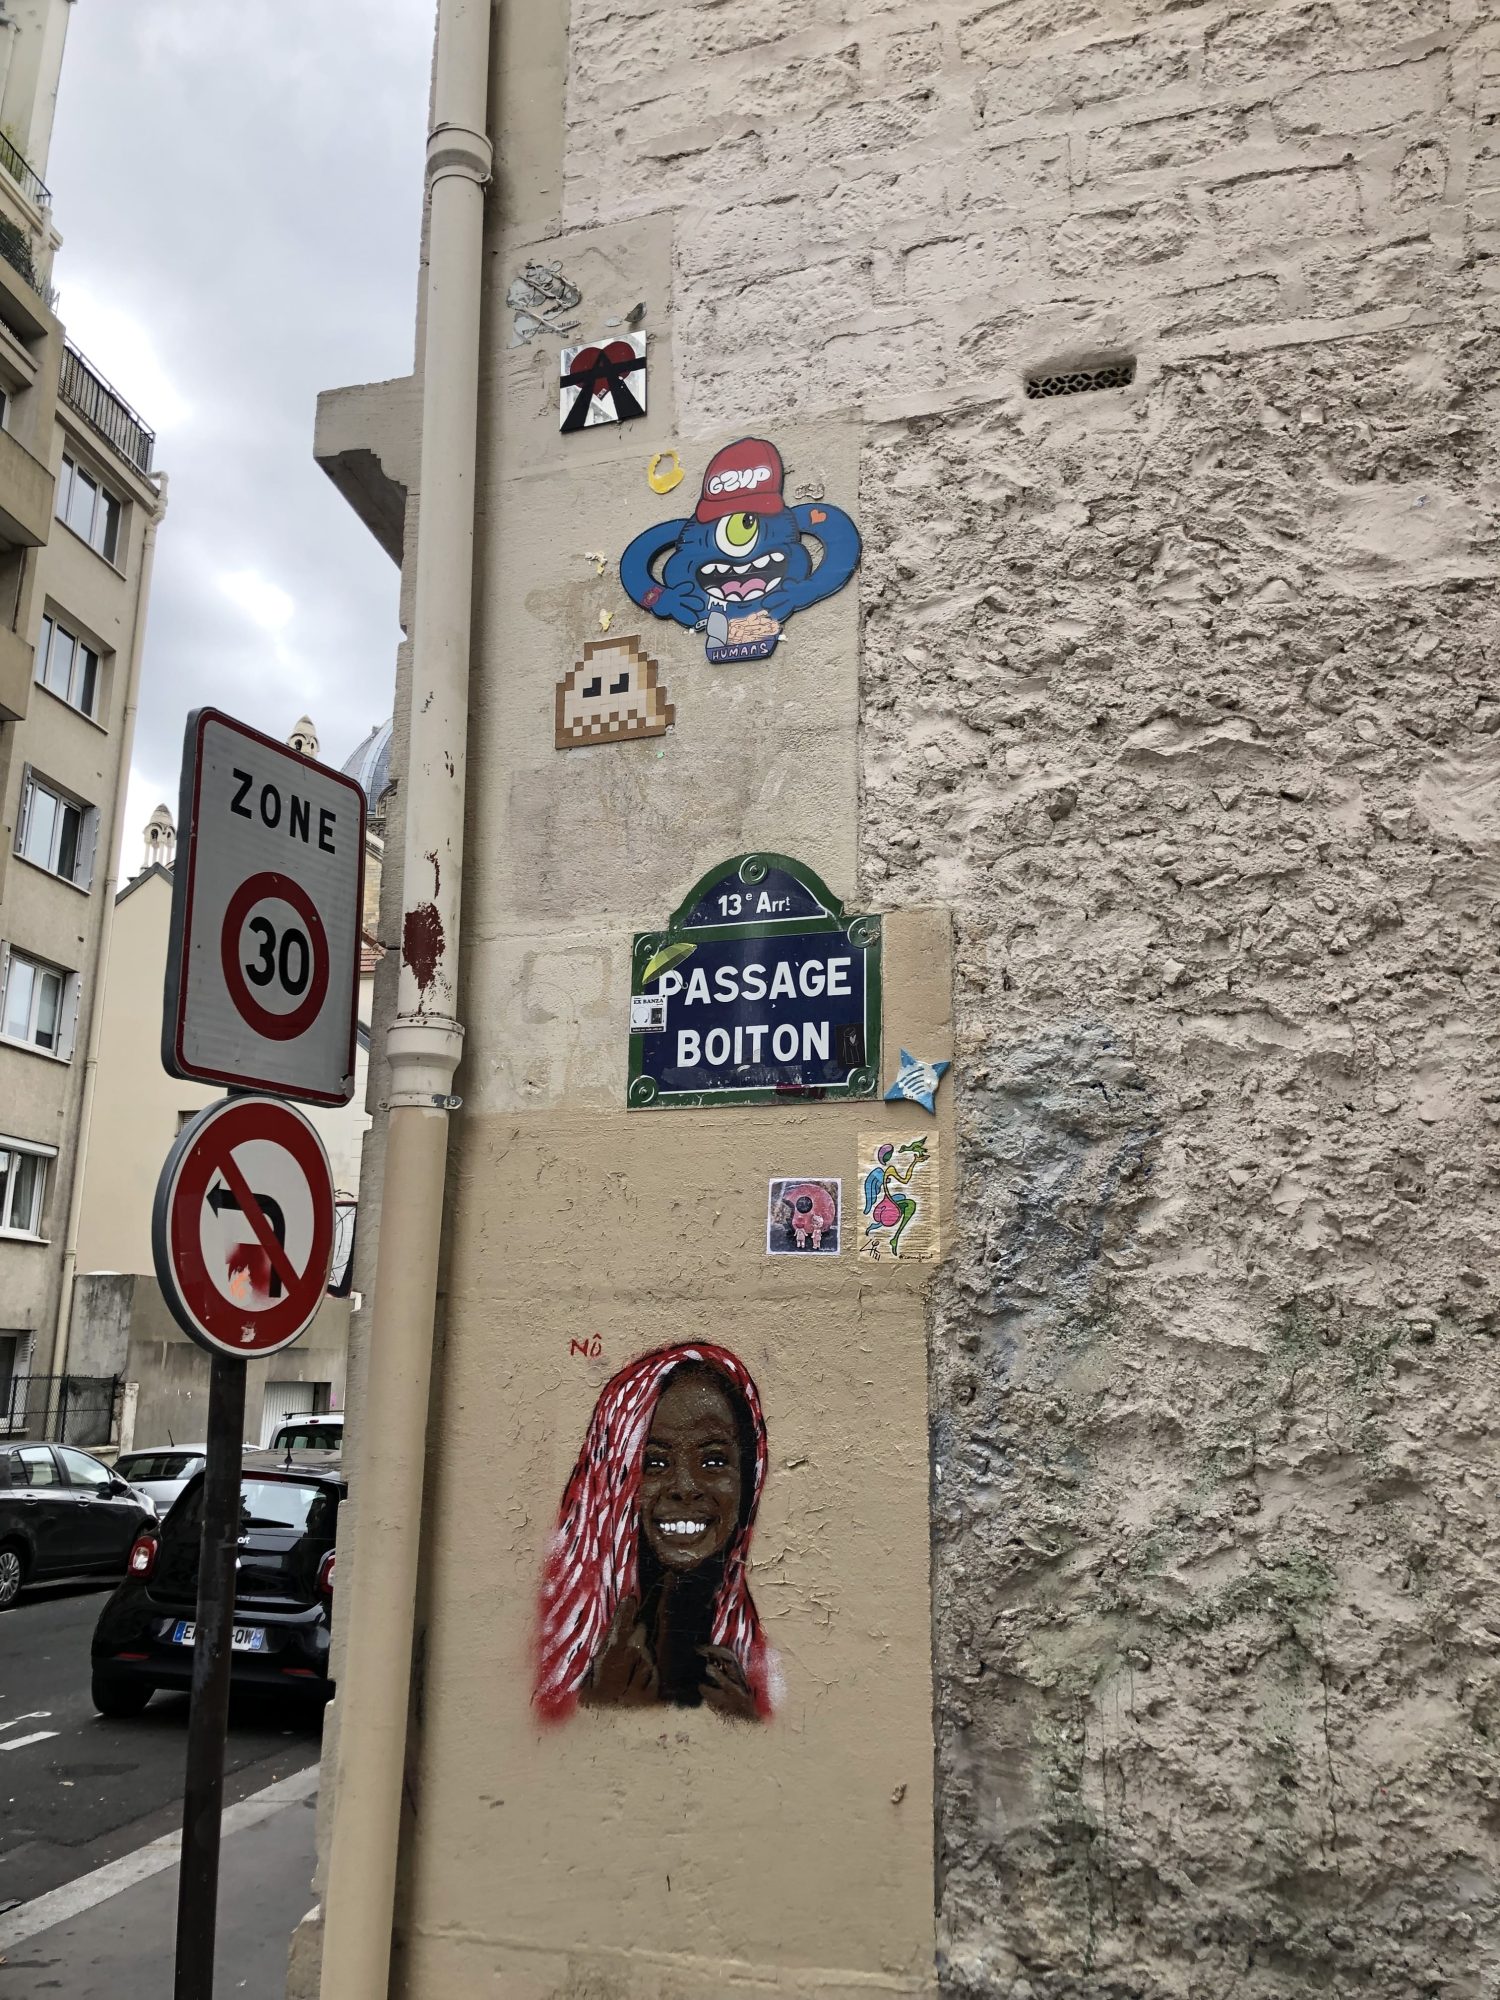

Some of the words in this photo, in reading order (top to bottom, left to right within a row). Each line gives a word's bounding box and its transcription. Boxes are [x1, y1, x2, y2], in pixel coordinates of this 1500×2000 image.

[231, 767, 336, 855] ZONE
[246, 916, 309, 996] 30
[659, 957, 852, 1006] PASSAGE
[677, 1021, 829, 1067] BOITON
[237, 1536, 251, 1545] art
